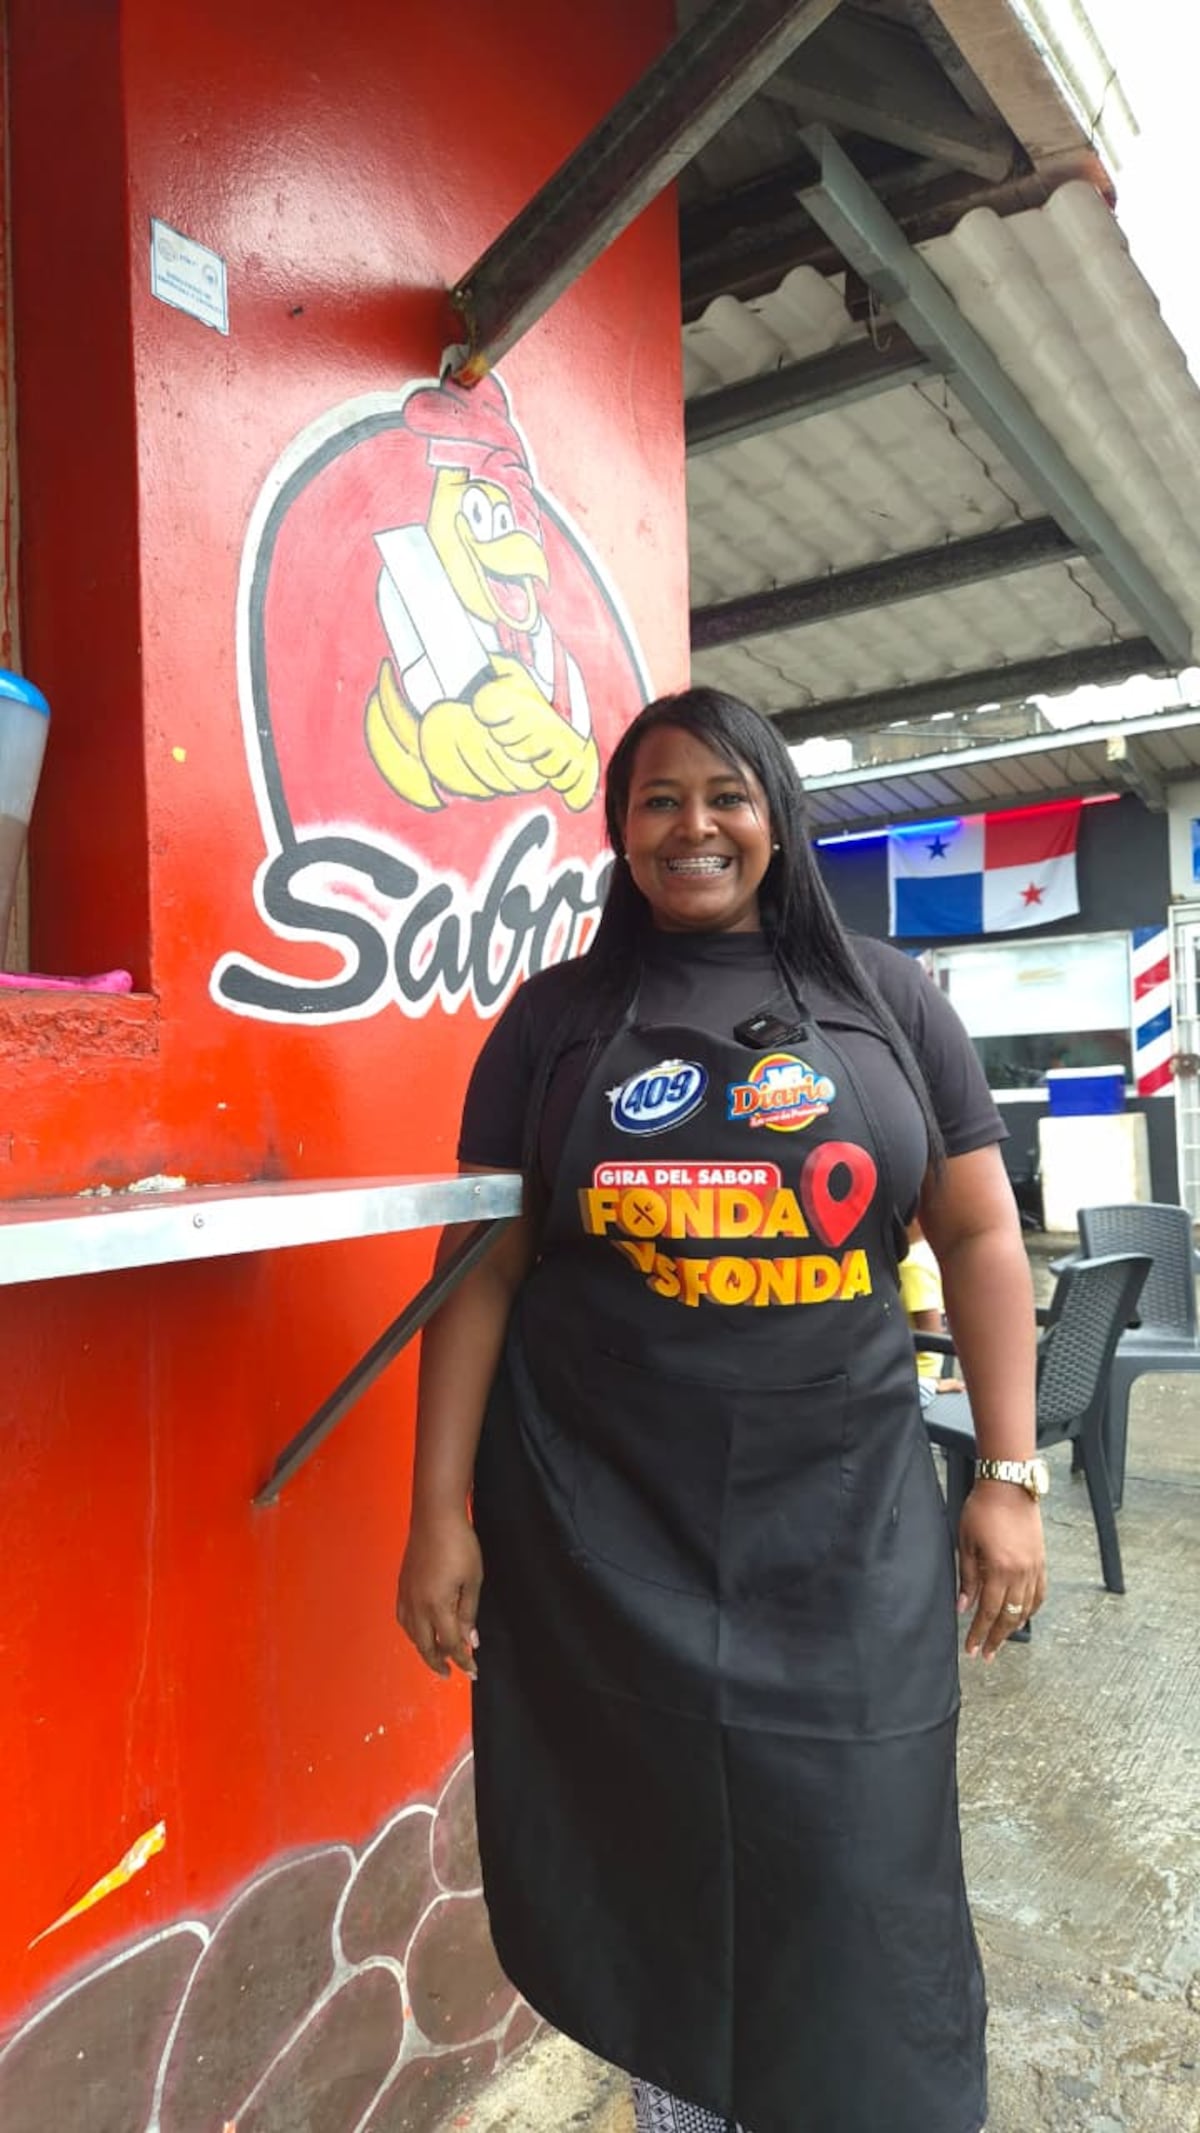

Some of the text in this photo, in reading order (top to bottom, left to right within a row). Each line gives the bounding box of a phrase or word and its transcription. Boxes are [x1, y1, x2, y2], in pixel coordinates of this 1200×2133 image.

[625, 1070, 694, 1114] 409
[731, 1075, 835, 1116] Diario
[600, 1169, 767, 1185] GIRA DEL SABOR
[581, 1188, 809, 1239] FONDA
[679, 1249, 872, 1307] FONDA
